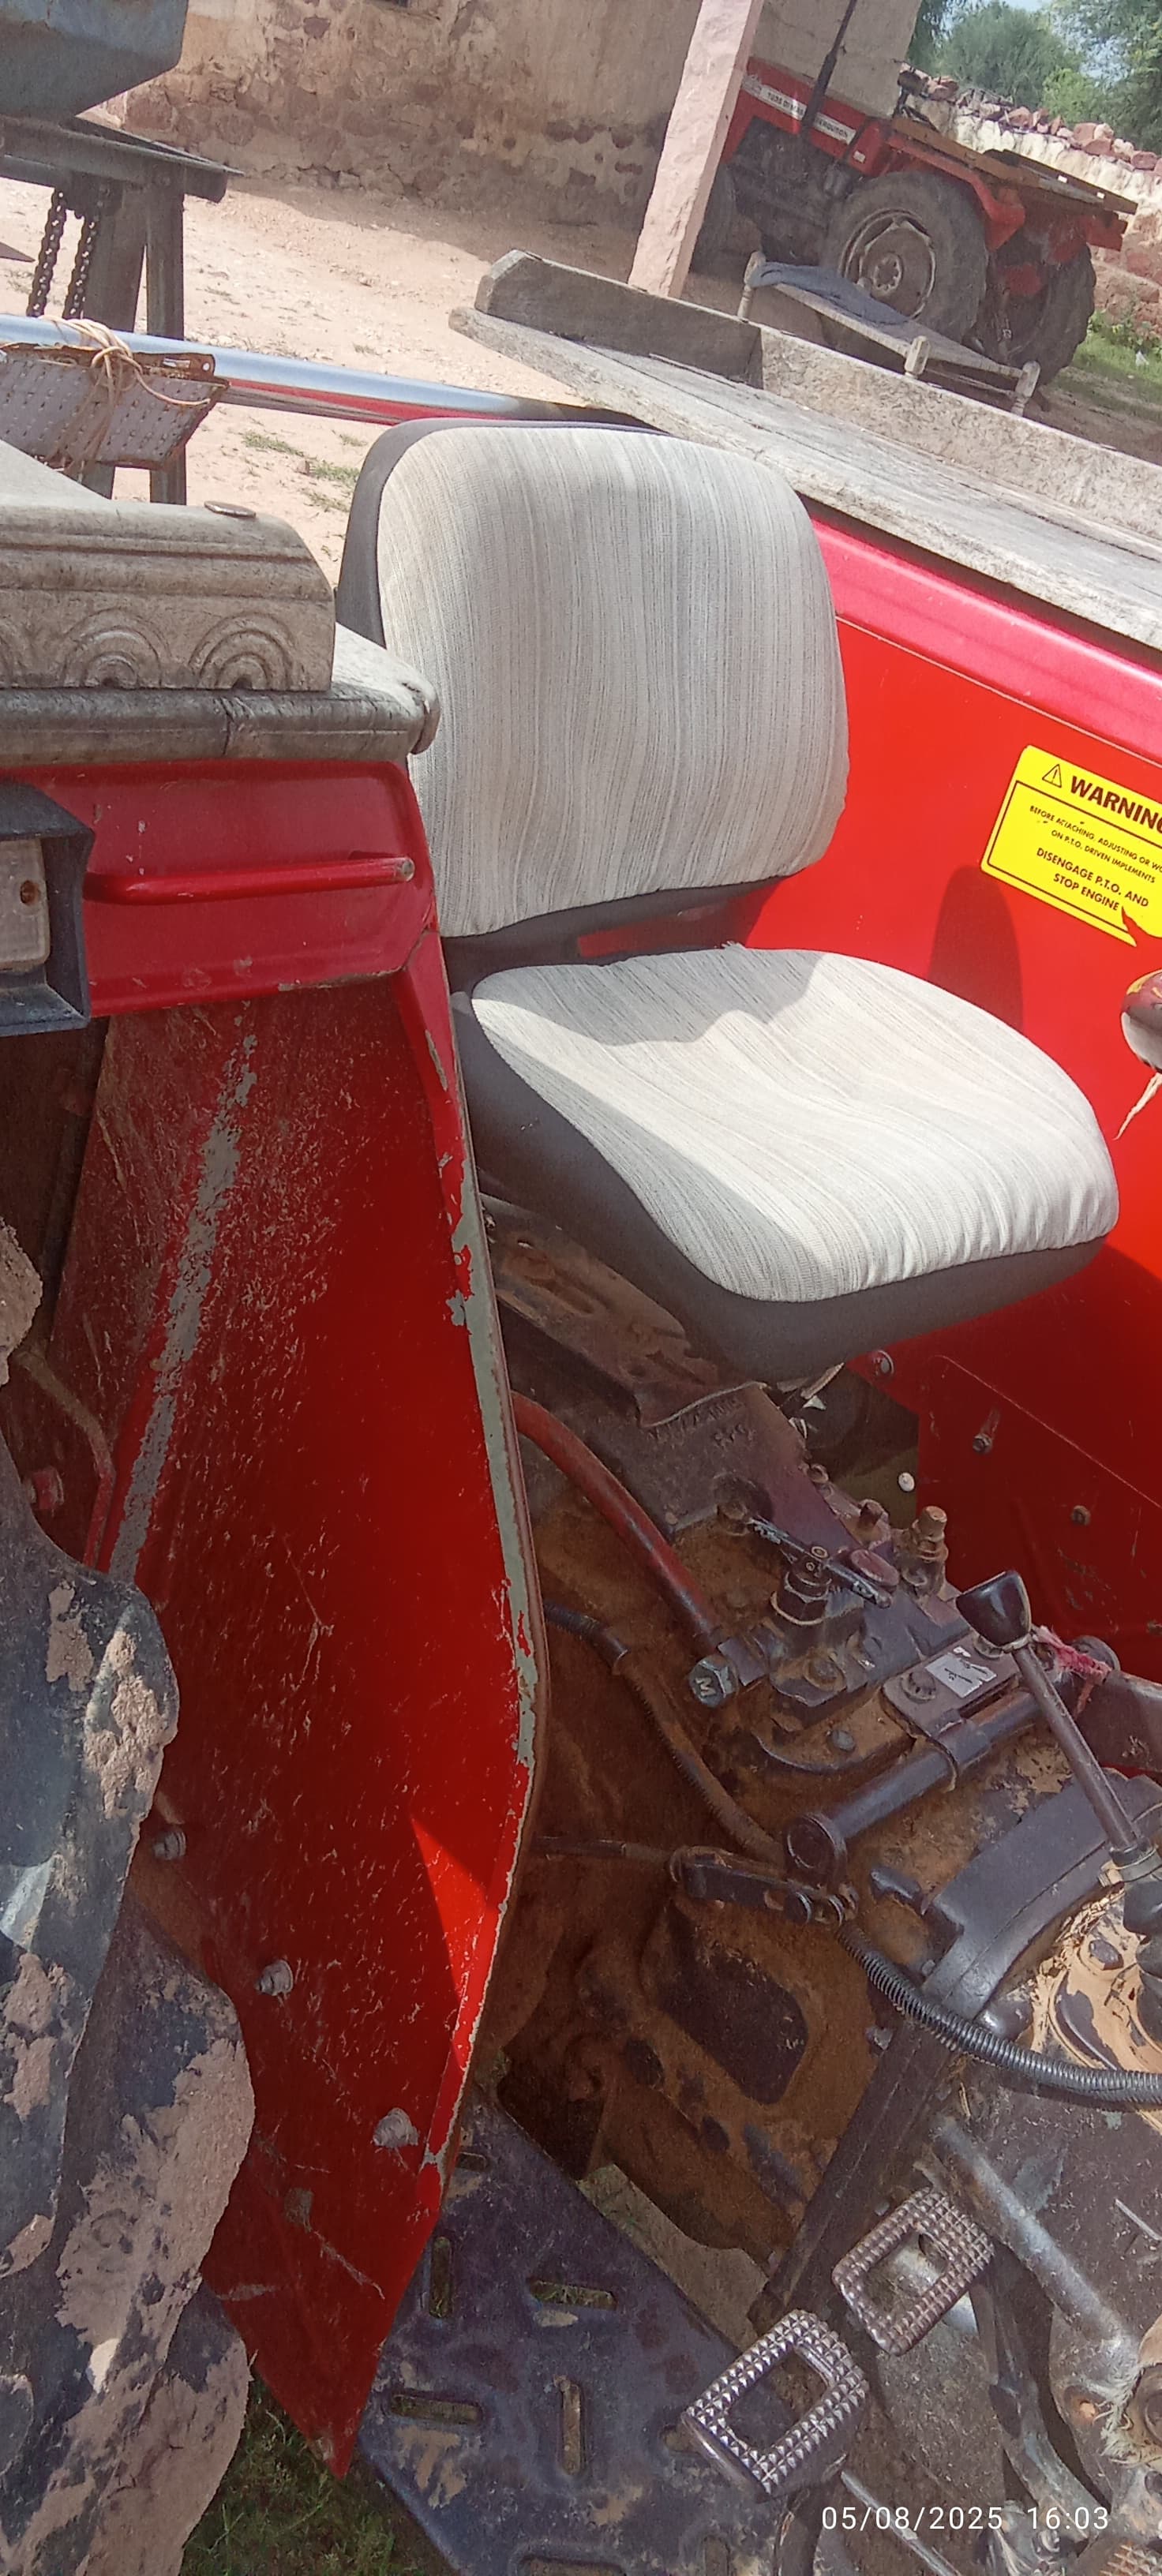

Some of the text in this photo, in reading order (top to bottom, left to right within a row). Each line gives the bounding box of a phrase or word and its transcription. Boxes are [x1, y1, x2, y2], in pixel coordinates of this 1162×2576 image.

[1029, 805, 1055, 822] BEFORE
[1097, 837, 1138, 860] ADJUSTING
[1139, 856, 1150, 867] OR
[1051, 829, 1063, 841] ON
[1084, 844, 1111, 862] DRIVEN
[1111, 856, 1156, 883] IMPLEMENTS
[1036, 848, 1149, 908] DISENGAGE P.T.O. AND
[1053, 873, 1119, 911] STOP ENGINE
